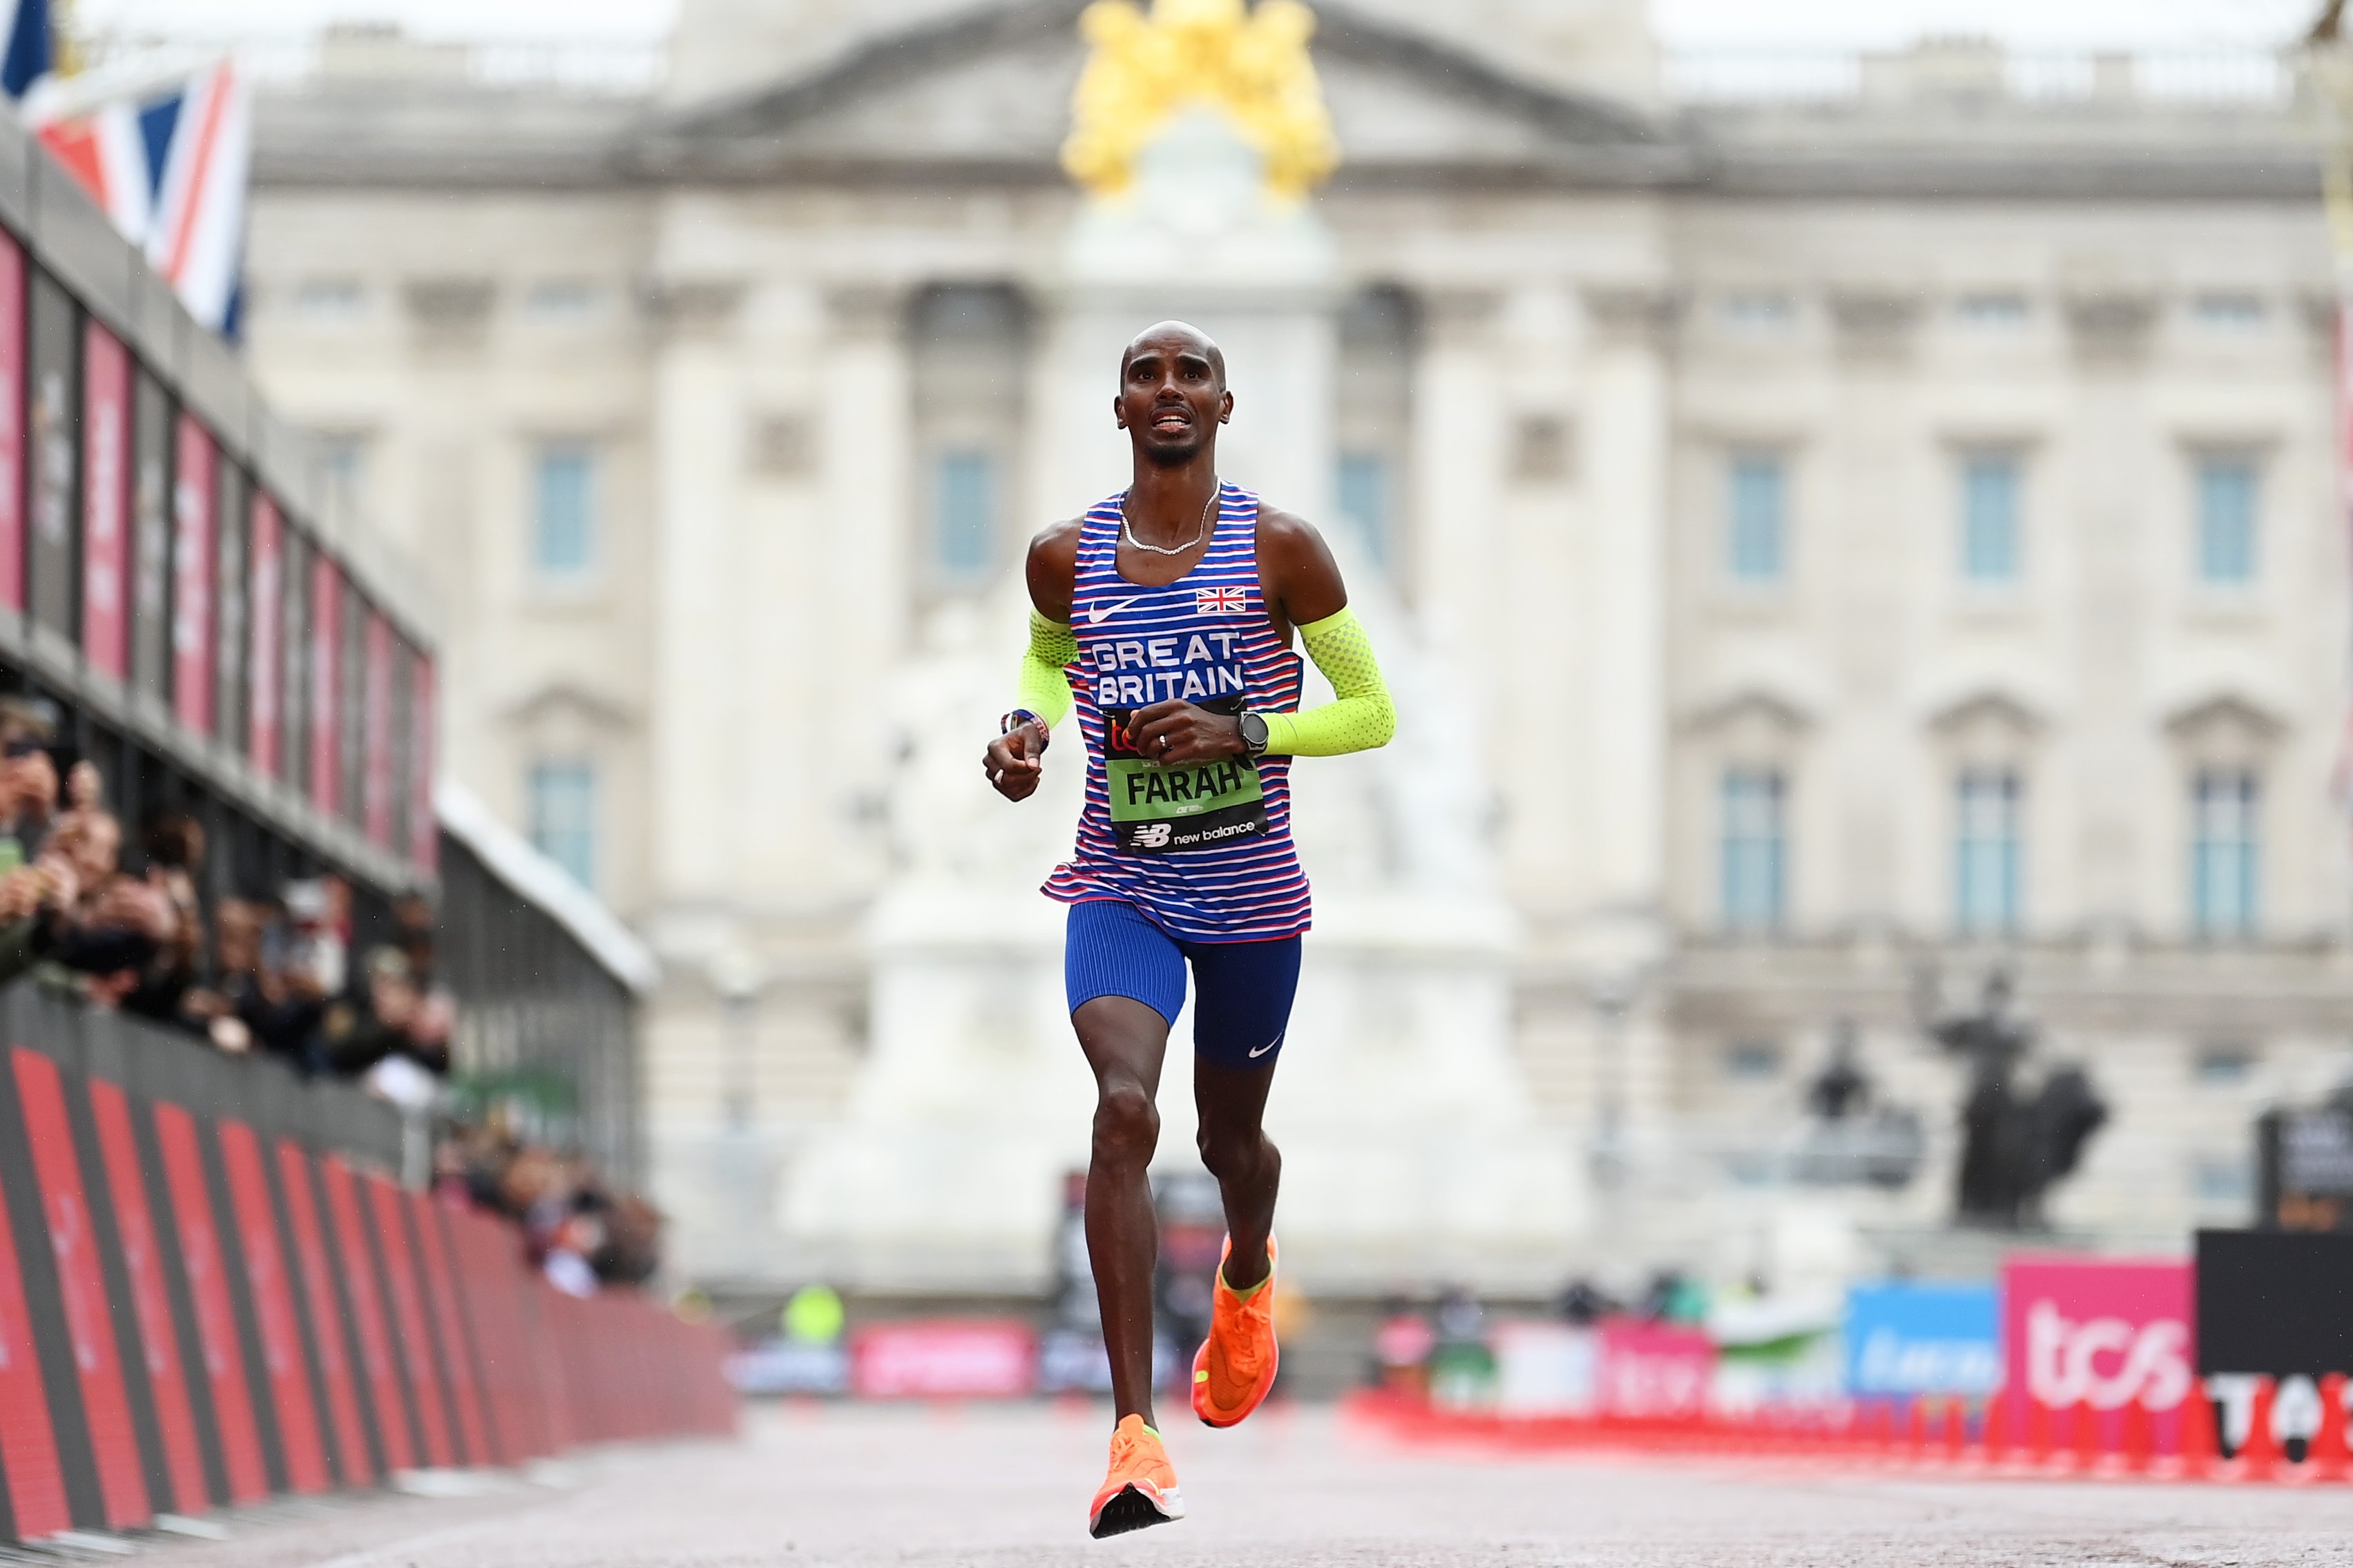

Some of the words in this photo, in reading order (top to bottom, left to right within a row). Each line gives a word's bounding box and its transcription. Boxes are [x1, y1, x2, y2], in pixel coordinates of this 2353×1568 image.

[1091, 631, 1240, 672] GREAT
[1097, 664, 1244, 705] BRITAIN
[1126, 759, 1242, 805] FARAH
[1173, 832, 1200, 846] new
[1202, 822, 1256, 841] balance
[2025, 1297, 2193, 1412] tcs
